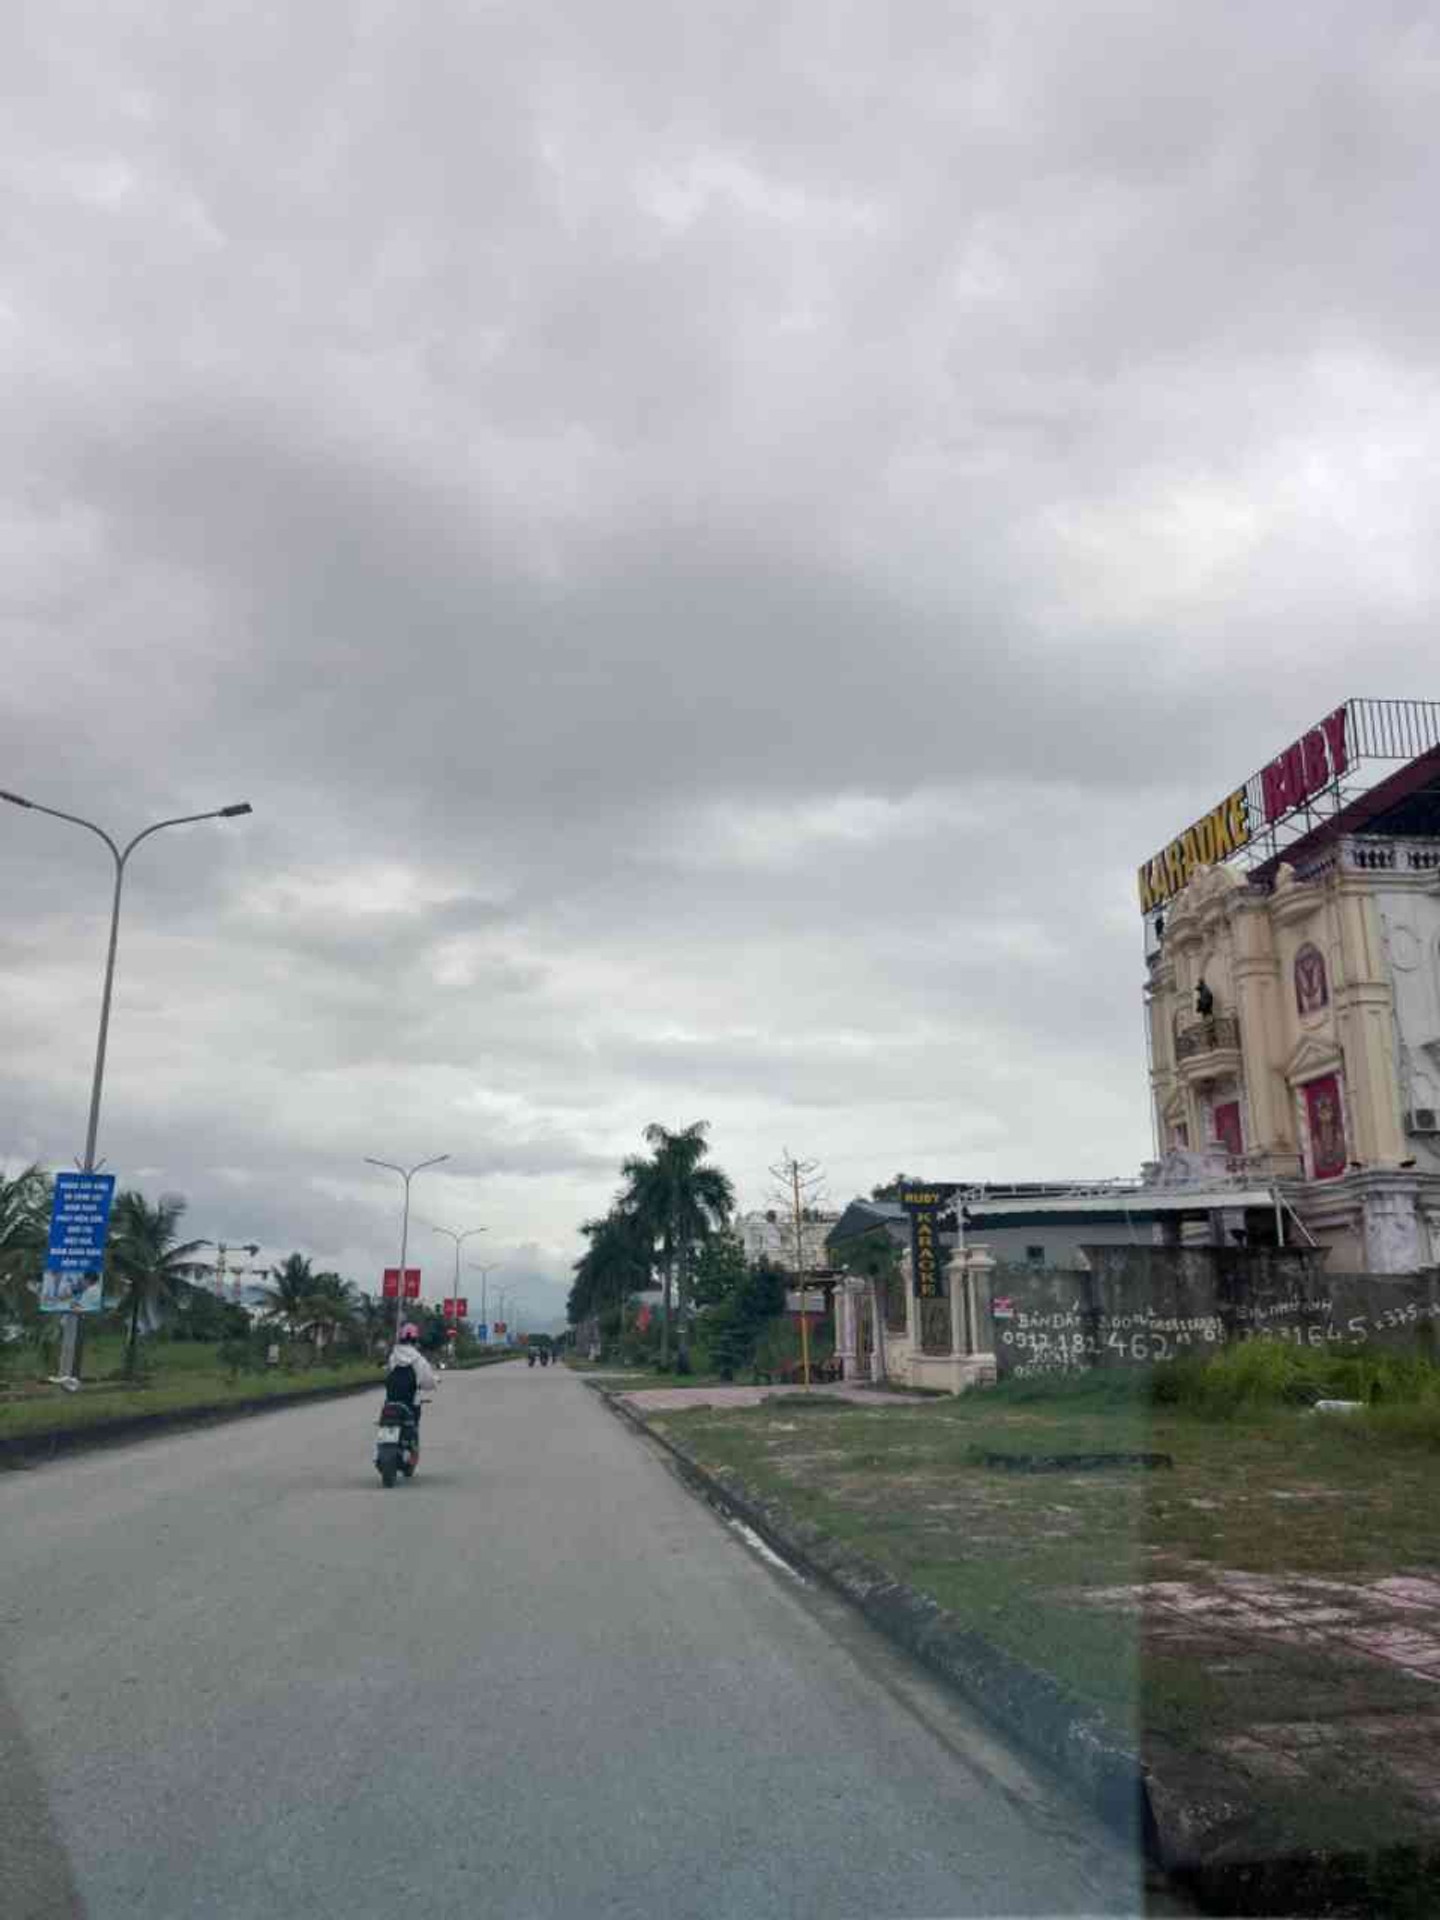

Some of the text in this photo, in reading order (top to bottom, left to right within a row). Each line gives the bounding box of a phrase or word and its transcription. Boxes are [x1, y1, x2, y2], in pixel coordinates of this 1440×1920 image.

[1138, 706, 1348, 914] KARAOKE RUBY
[904, 1191, 938, 1205] RUBY
[917, 1211, 936, 1297] KARAOKE
